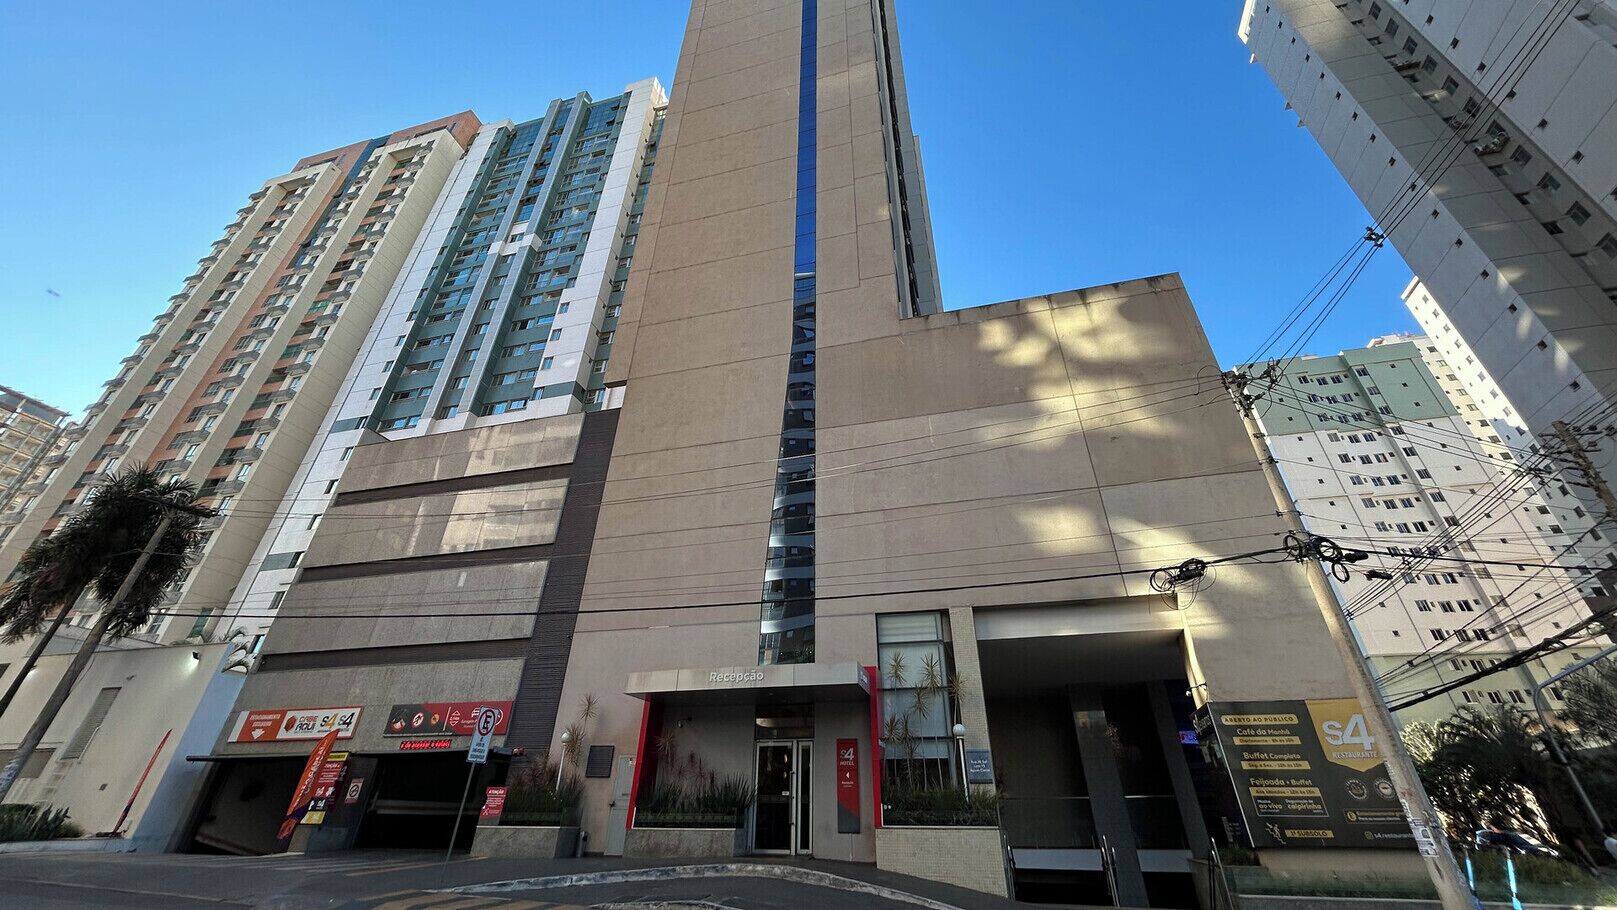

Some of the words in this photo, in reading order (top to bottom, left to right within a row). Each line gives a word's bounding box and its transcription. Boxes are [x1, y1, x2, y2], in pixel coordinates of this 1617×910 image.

[709, 670, 764, 683] Recepção
[295, 722, 317, 731] AQUI
[1269, 752, 1301, 760] Completo
[1332, 751, 1378, 759] RESTAURANTE
[1250, 778, 1286, 787] Feijoada
[1290, 778, 1313, 786] Buffet
[1287, 803, 1322, 811] caipirinha
